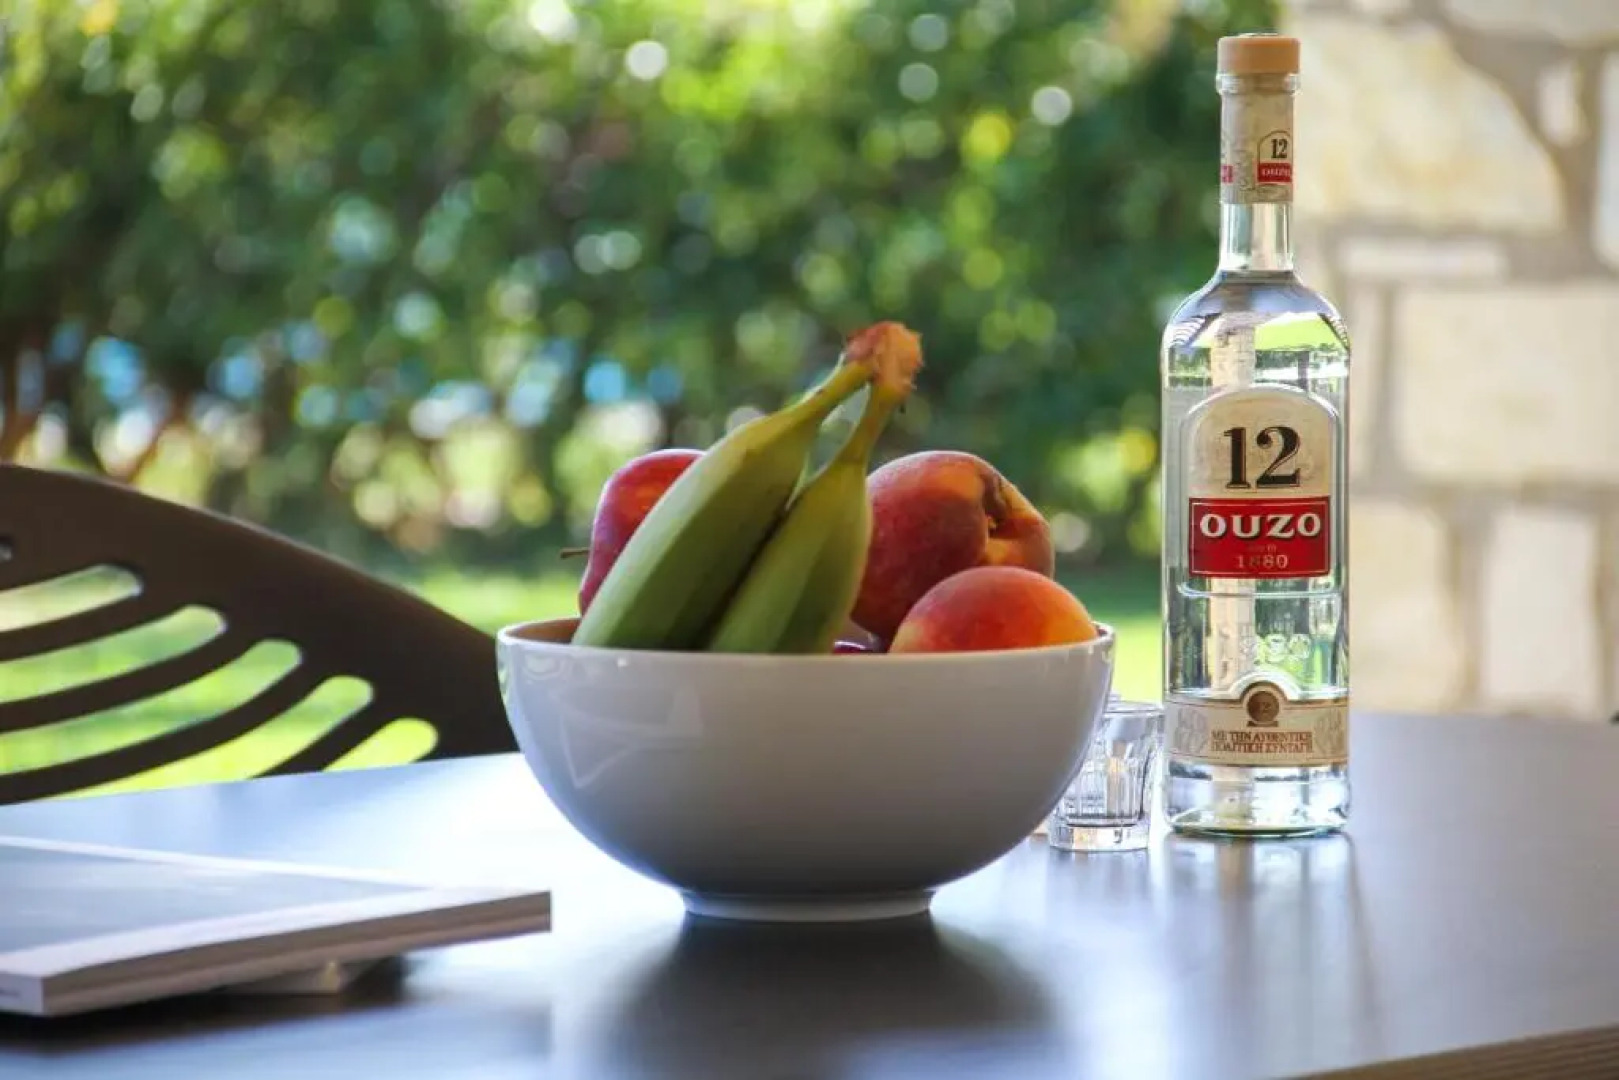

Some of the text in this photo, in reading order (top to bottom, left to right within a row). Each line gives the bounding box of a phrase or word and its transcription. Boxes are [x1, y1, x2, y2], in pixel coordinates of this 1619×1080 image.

[1271, 138, 1288, 159] 12
[1223, 427, 1301, 489] 12
[1199, 513, 1321, 539] OUZO
